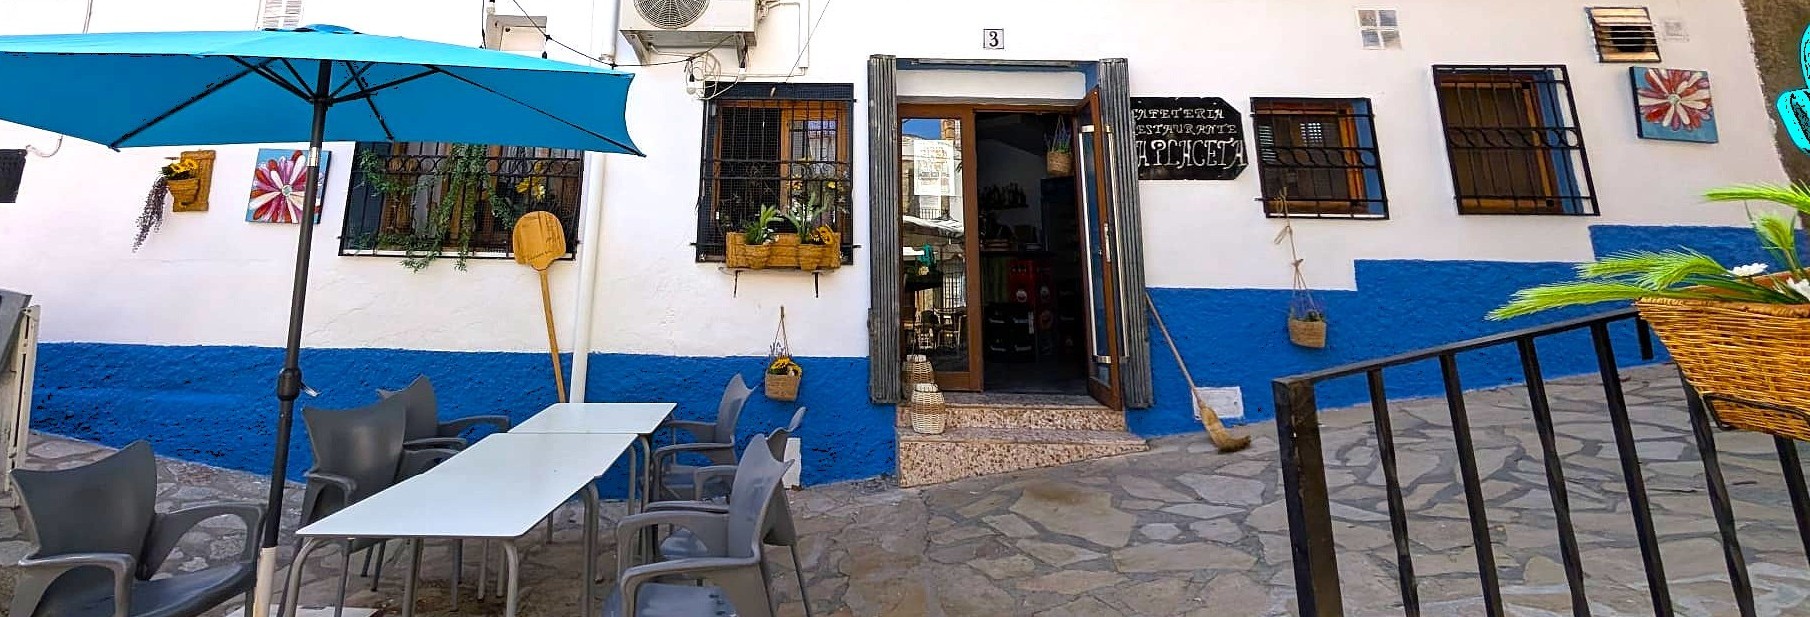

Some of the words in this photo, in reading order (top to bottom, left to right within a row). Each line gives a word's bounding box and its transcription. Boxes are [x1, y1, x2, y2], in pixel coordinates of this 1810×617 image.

[989, 31, 999, 47] 3
[1131, 108, 1225, 120] CAFETERIA
[1134, 123, 1237, 135] ESTAURANTE
[1136, 139, 1150, 167] A
[1151, 137, 1247, 169] PLACETA
